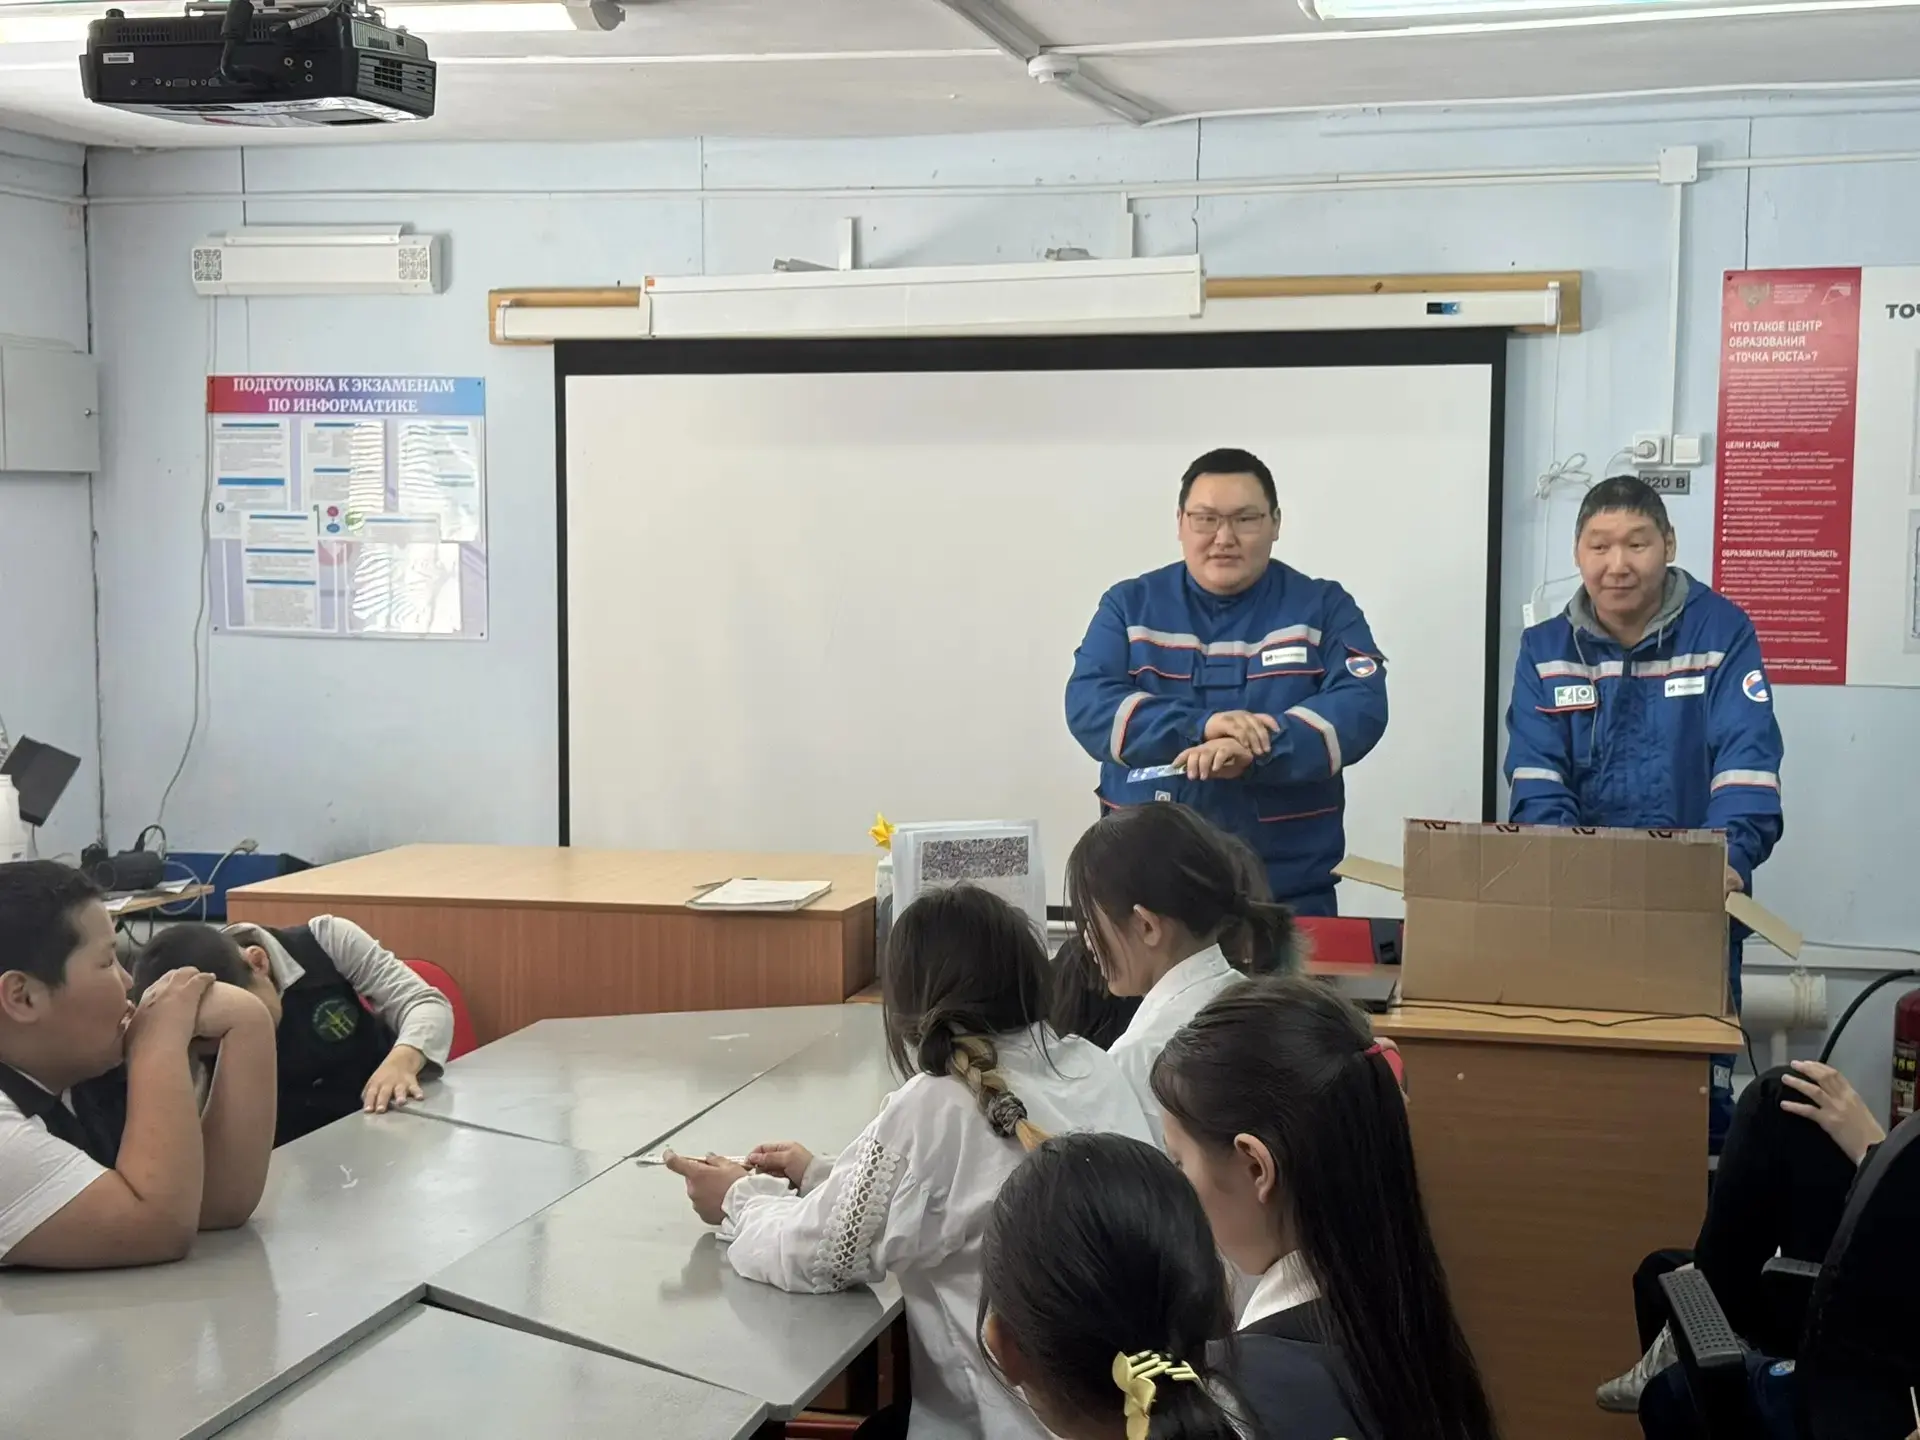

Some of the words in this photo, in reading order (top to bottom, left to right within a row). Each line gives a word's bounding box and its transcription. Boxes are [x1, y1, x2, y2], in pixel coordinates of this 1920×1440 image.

[1729, 321, 1750, 333] ЧТО
[1753, 321, 1785, 332] ТАКОЕ
[1787, 320, 1823, 333] ЦЕНТР
[1728, 335, 1806, 348] ОБРАЗОВАНИЯ
[1728, 351, 1769, 363] «ТОЧКА
[1772, 350, 1818, 363] РОСТА»?
[233, 377, 336, 395] ПОДГОТОВКА
[338, 377, 350, 392] К
[351, 377, 456, 393] ЭКЗАМЕНАМ
[268, 397, 291, 413] ПО
[293, 397, 418, 413] ИНФОРМАТИКЕ
[1725, 440, 1744, 450] ЦЕЛИ
[1745, 440, 1751, 449] И
[1752, 440, 1780, 450] ЗАДАЧИ
[1721, 549, 1785, 558] ОБРАЗОВАТЕЛЬНАЯ
[1786, 549, 1838, 559] ДЕЯТЕЛЬНОСТЬ
